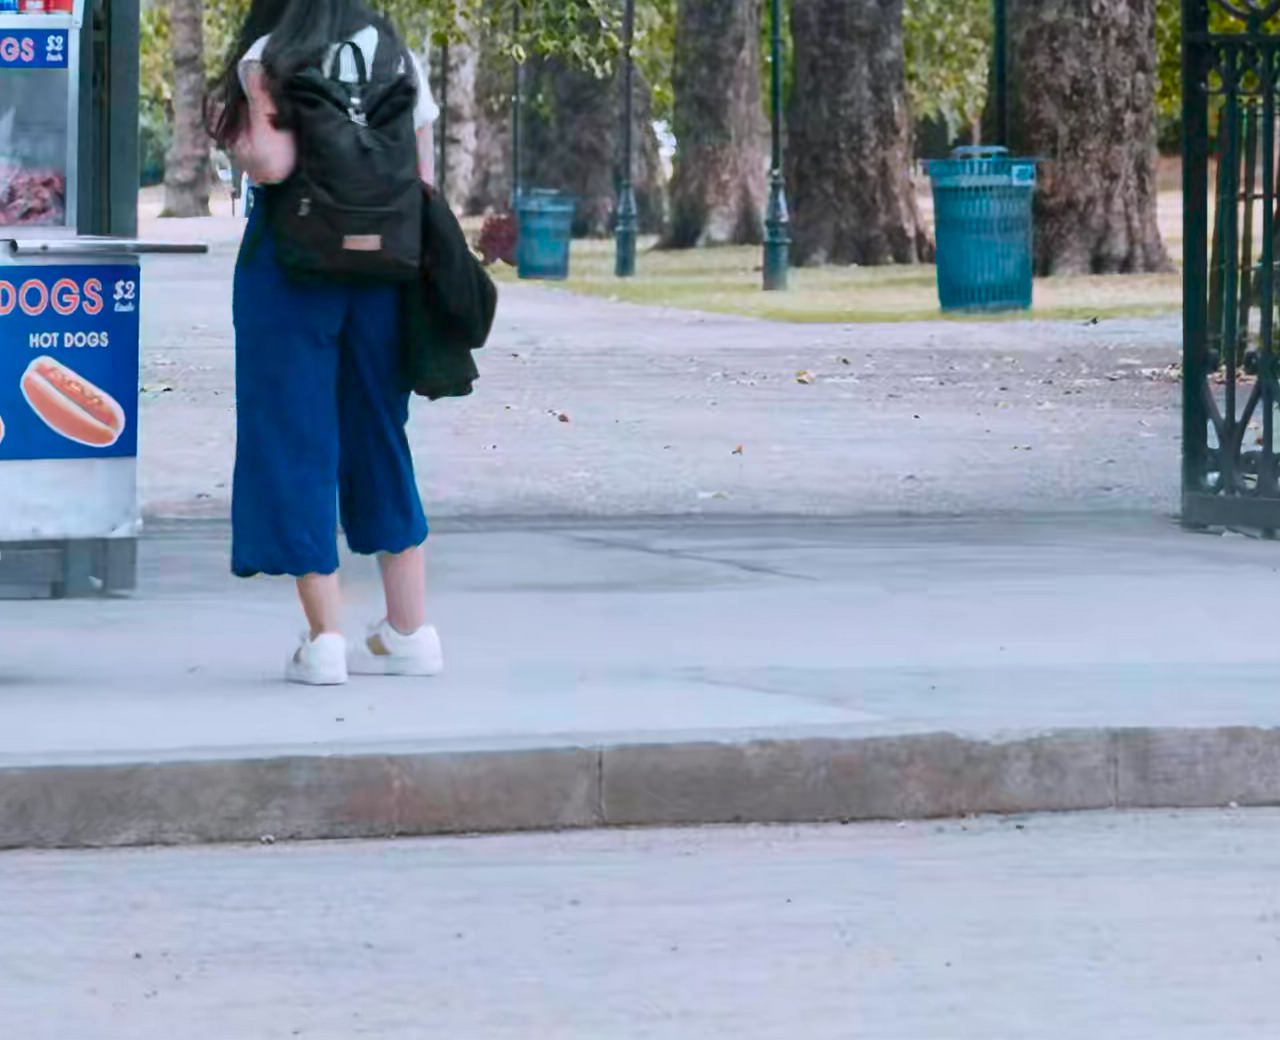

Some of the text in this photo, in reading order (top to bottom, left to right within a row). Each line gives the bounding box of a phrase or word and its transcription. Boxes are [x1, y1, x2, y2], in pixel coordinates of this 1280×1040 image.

[45, 35, 64, 51] $2
[112, 279, 135, 300] $2
[29, 331, 109, 348] HOT DOGS
